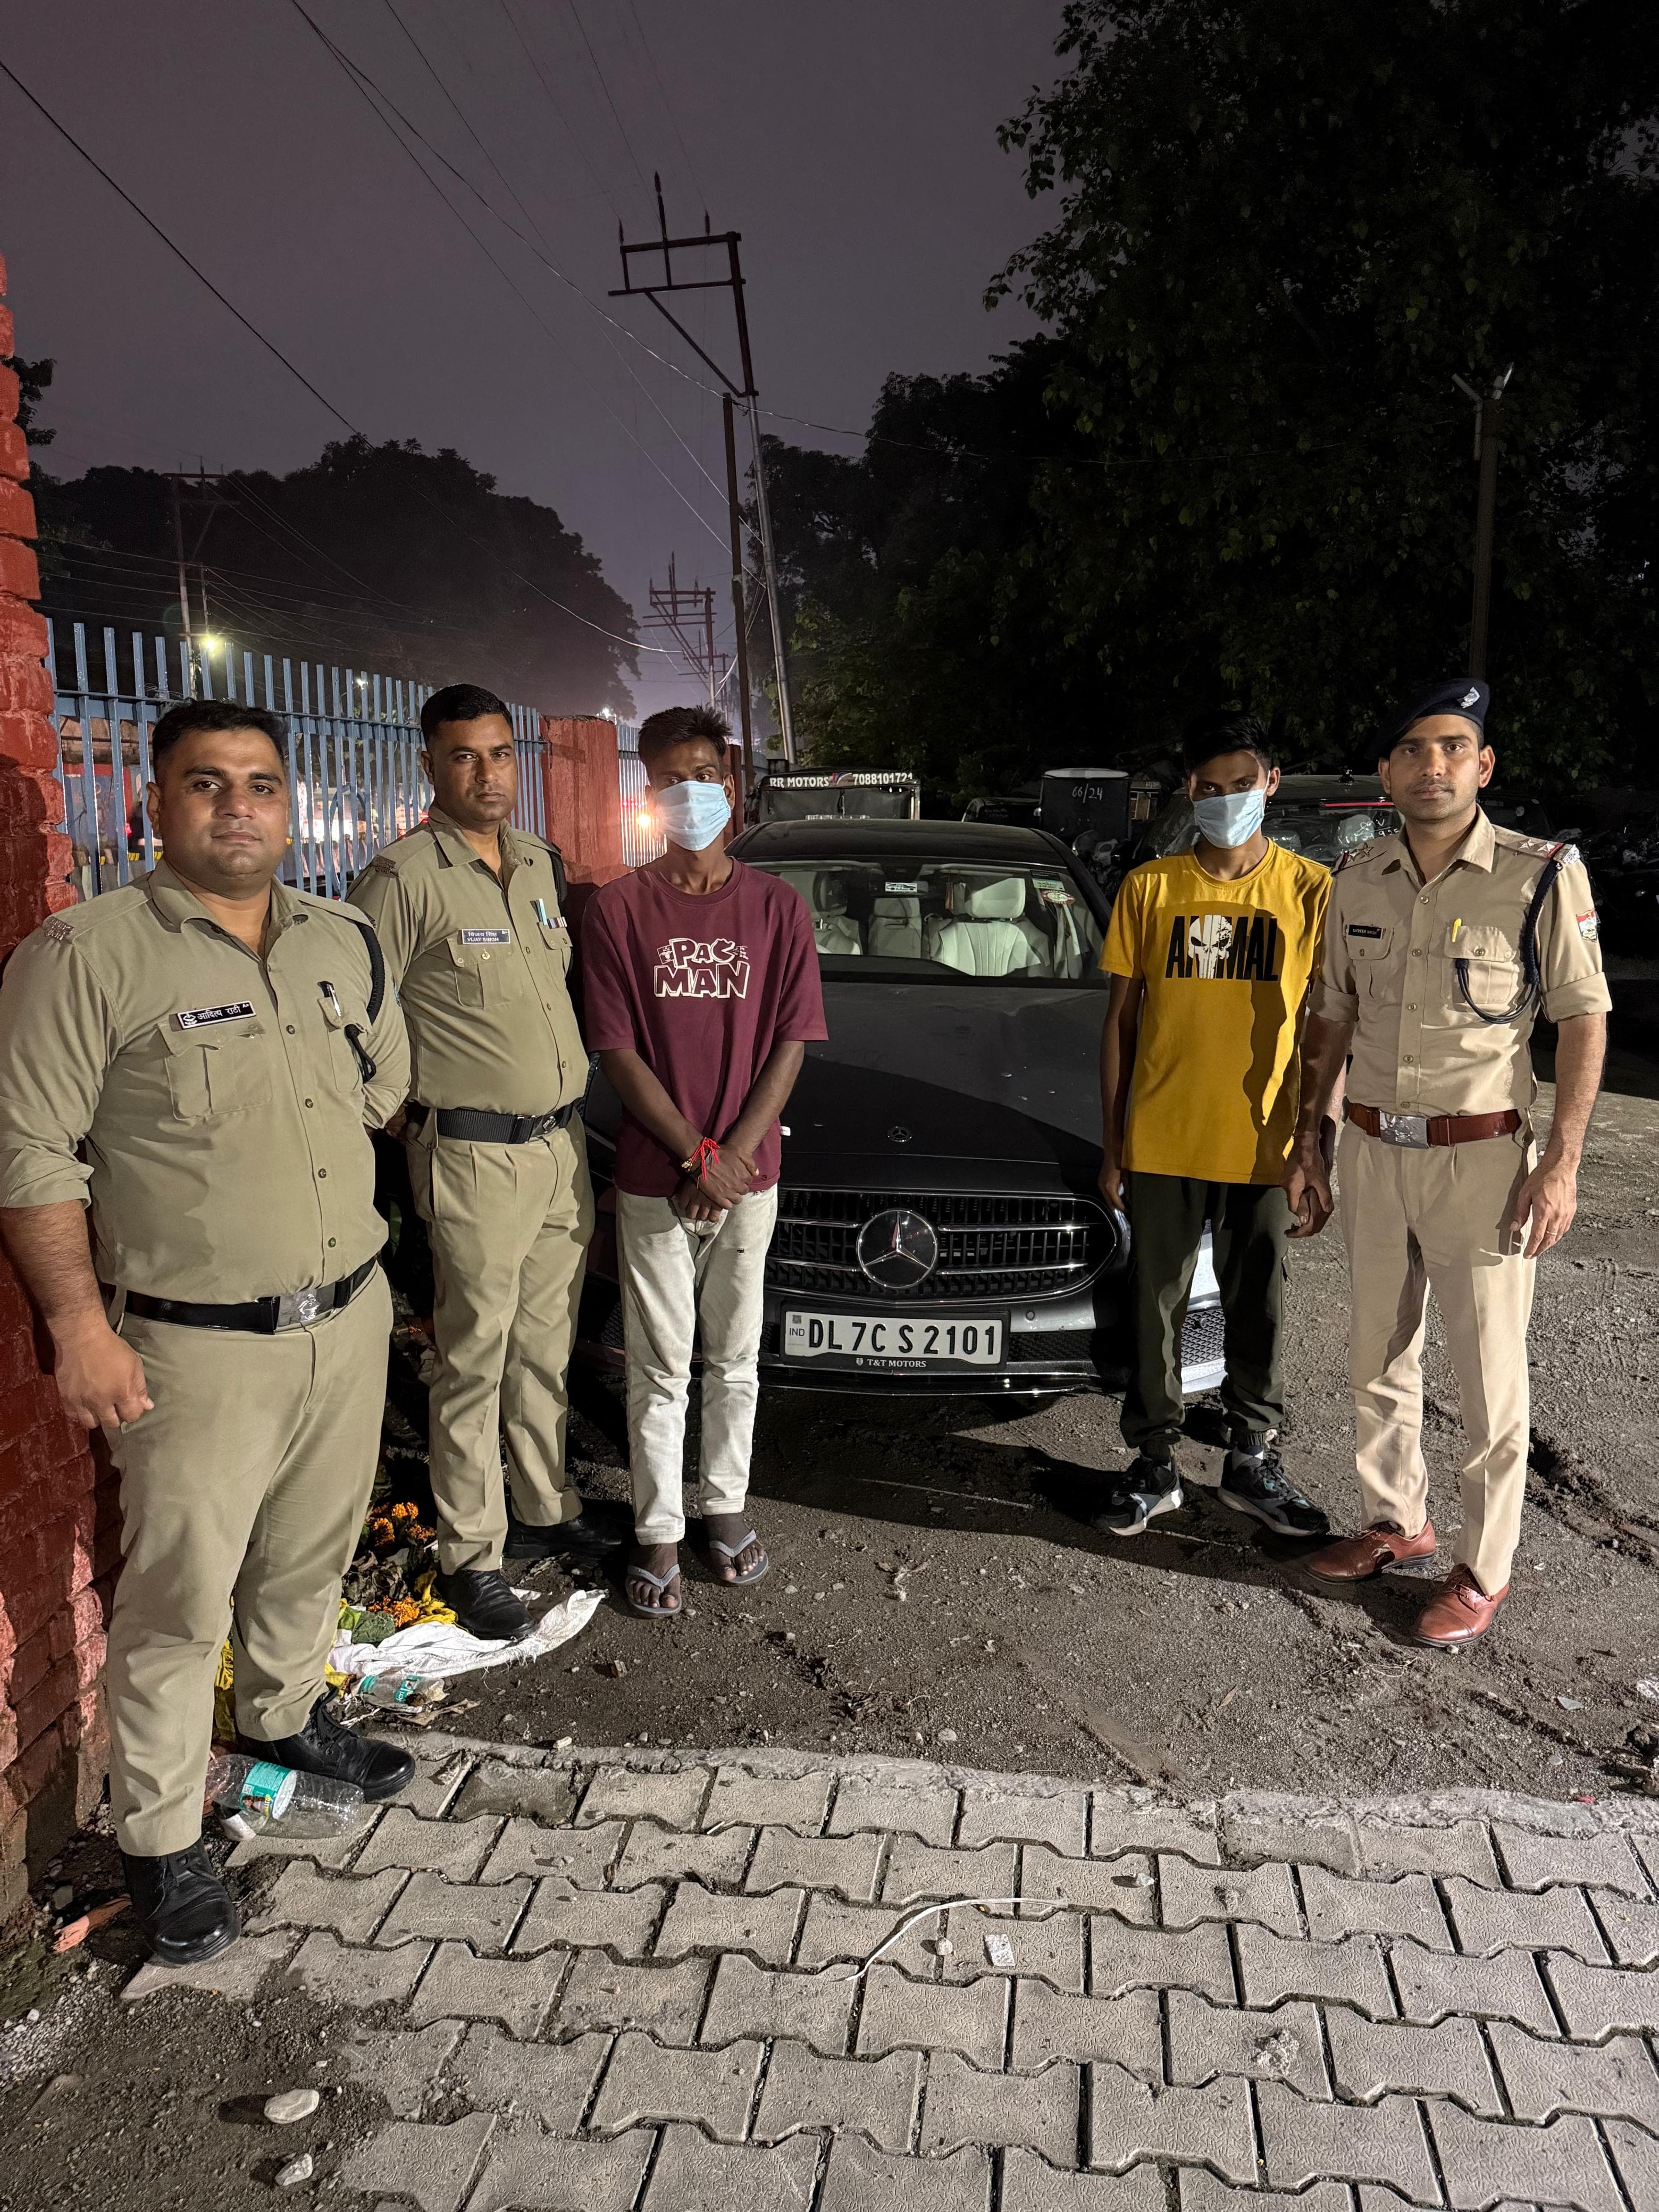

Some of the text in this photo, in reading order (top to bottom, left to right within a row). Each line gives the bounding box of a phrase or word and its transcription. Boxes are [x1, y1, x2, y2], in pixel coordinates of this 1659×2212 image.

[769, 772, 913, 789] RR MOTORS 7088101721
[1072, 783, 1103, 803] 66/24
[668, 937, 735, 968] PAC
[1165, 915, 1278, 981] ANIMAL
[654, 961, 750, 999] MAN
[197, 1004, 241, 1020] आदित्य राठी
[789, 1328, 805, 1337] IND
[808, 1319, 842, 1350] DL
[851, 1322, 886, 1352] 7C
